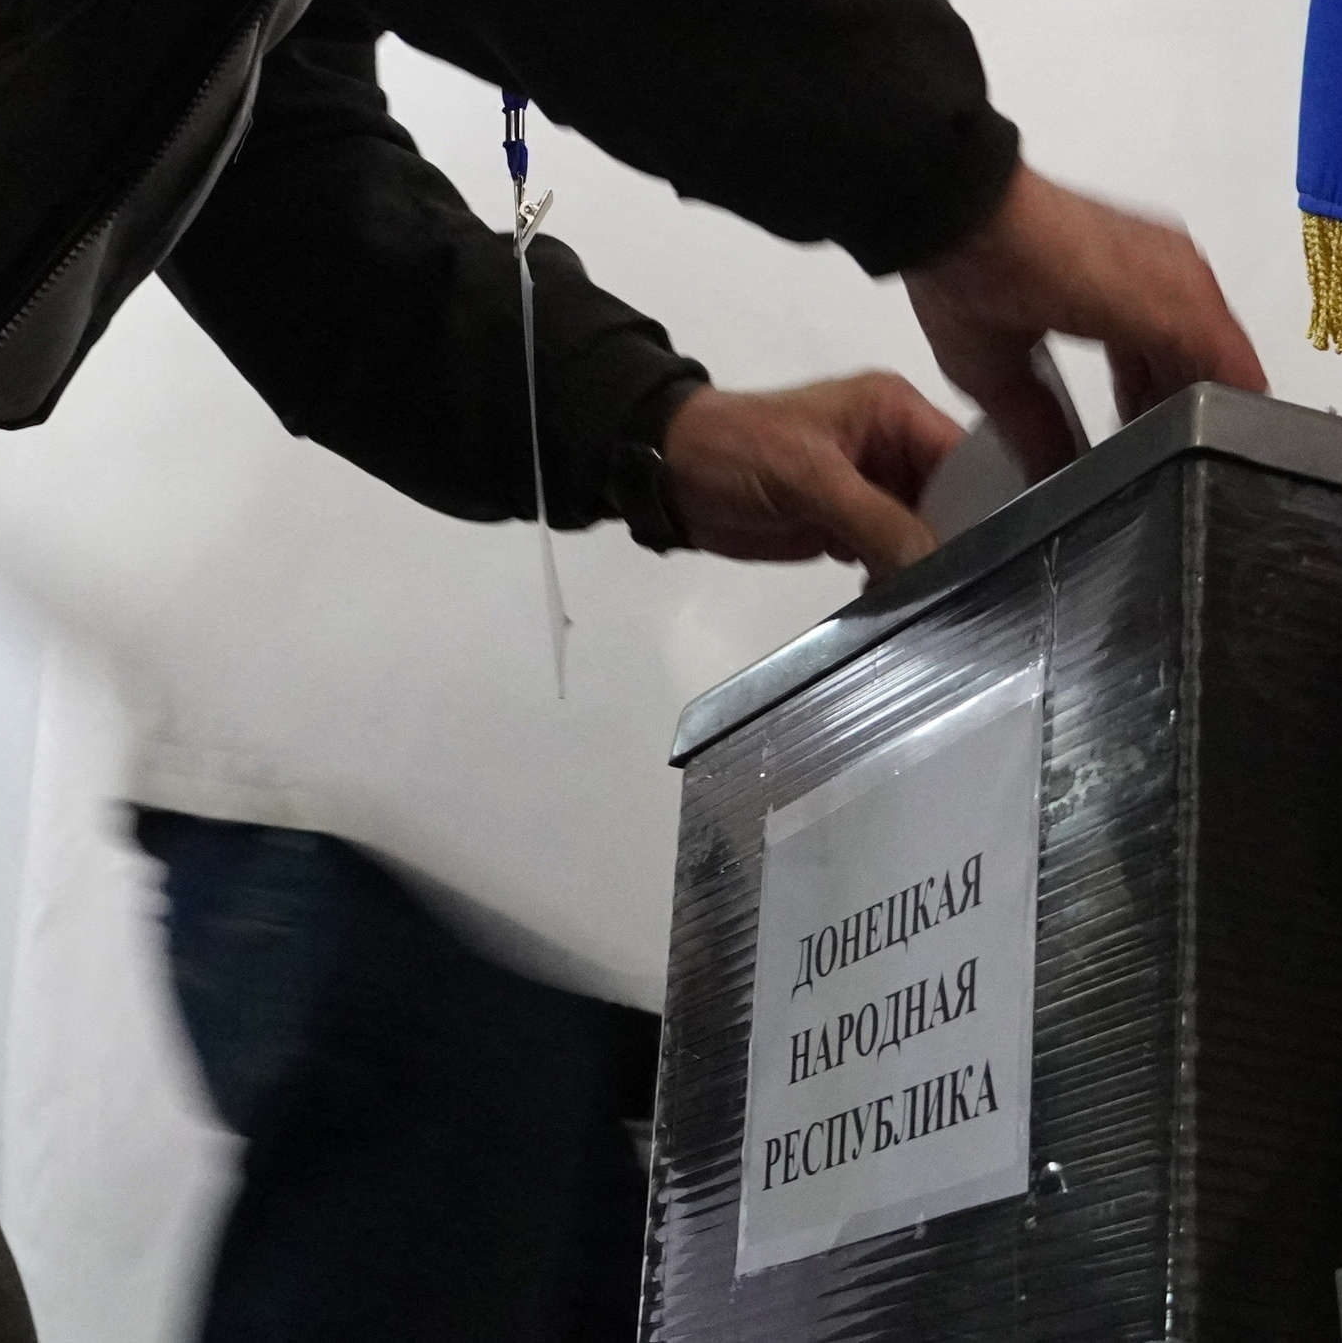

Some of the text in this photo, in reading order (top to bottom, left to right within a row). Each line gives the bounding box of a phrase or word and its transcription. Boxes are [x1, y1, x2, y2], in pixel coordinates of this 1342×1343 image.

[791, 851, 983, 1002] ДОНЕЦКАЯ
[787, 955, 979, 1086] НАРОДНАЯ
[761, 1059, 999, 1191] РЕСПУБЛИКА
